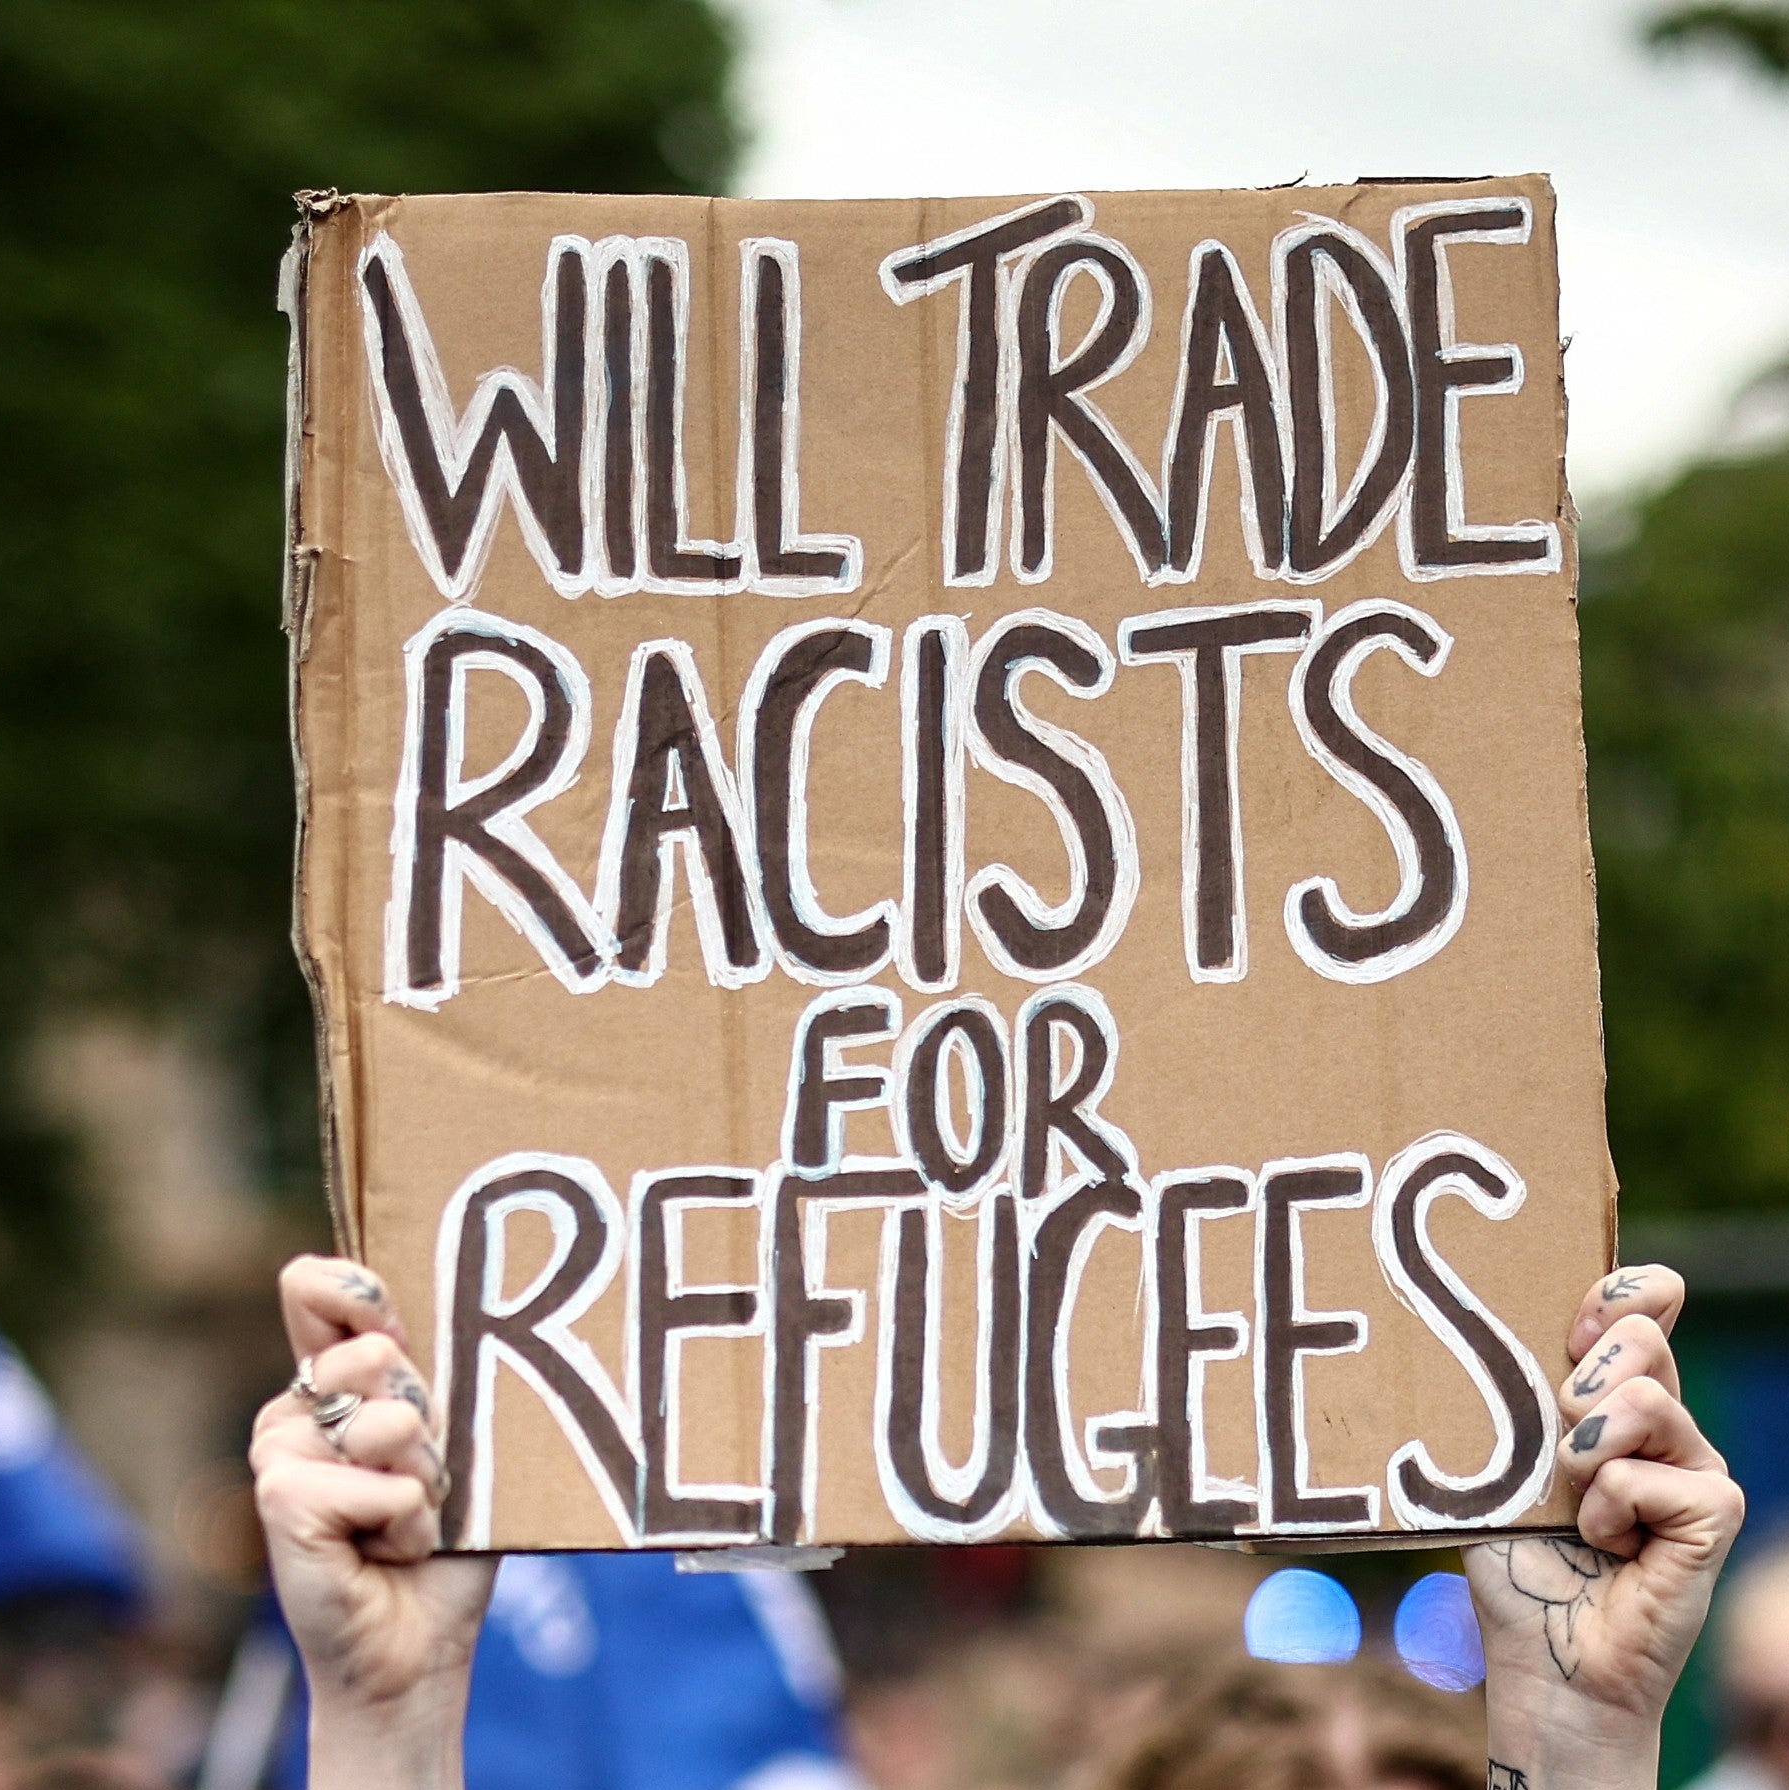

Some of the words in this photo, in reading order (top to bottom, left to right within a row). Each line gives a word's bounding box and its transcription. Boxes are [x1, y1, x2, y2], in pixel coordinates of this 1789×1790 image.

[360, 230, 864, 598] WILL
[880, 195, 1560, 584] TRADE
[383, 600, 1470, 1008] RACISTS
[783, 984, 1139, 1205] FOR
[432, 1130, 1560, 1546] REFUGEES
